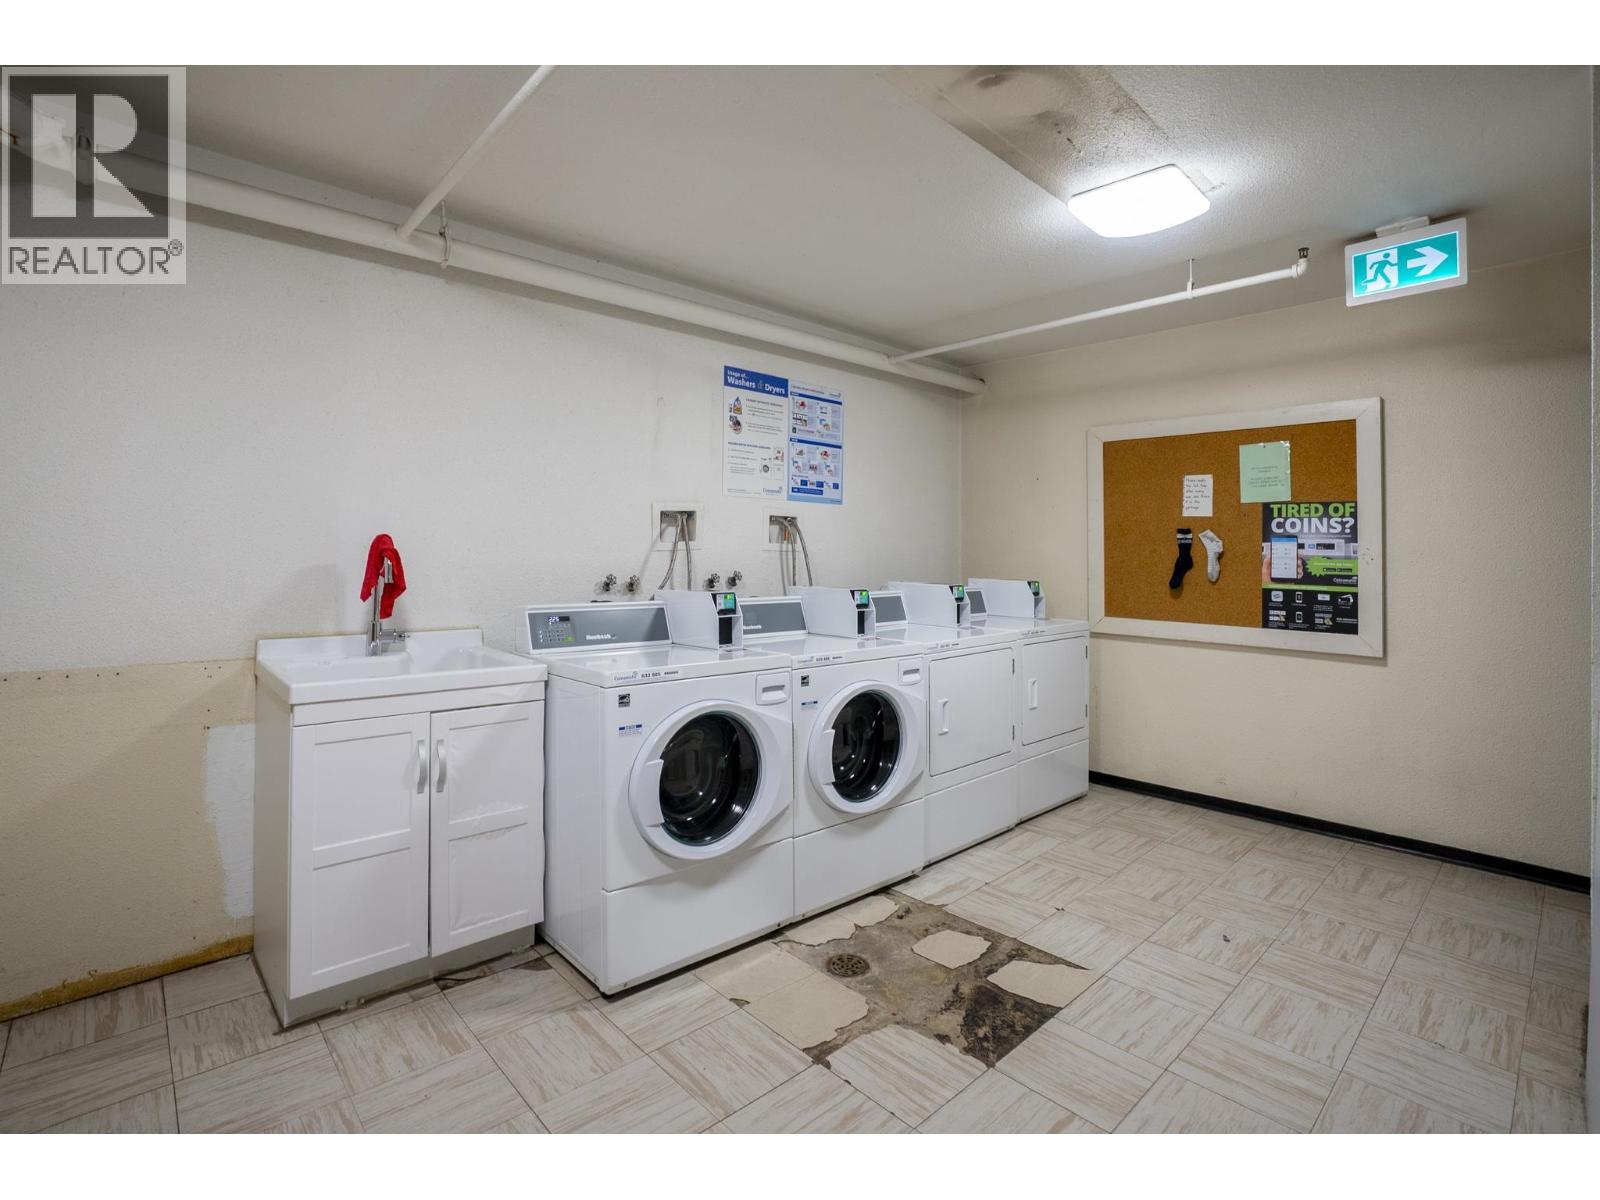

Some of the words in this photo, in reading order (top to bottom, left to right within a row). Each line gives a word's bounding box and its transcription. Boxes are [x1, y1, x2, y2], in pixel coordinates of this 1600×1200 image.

[727, 376, 756, 389] Washers
[764, 384, 786, 394] Dryers
[1270, 503, 1324, 518] TIRED
[1328, 502, 1356, 517] OF
[1271, 517, 1355, 534] COINS?
